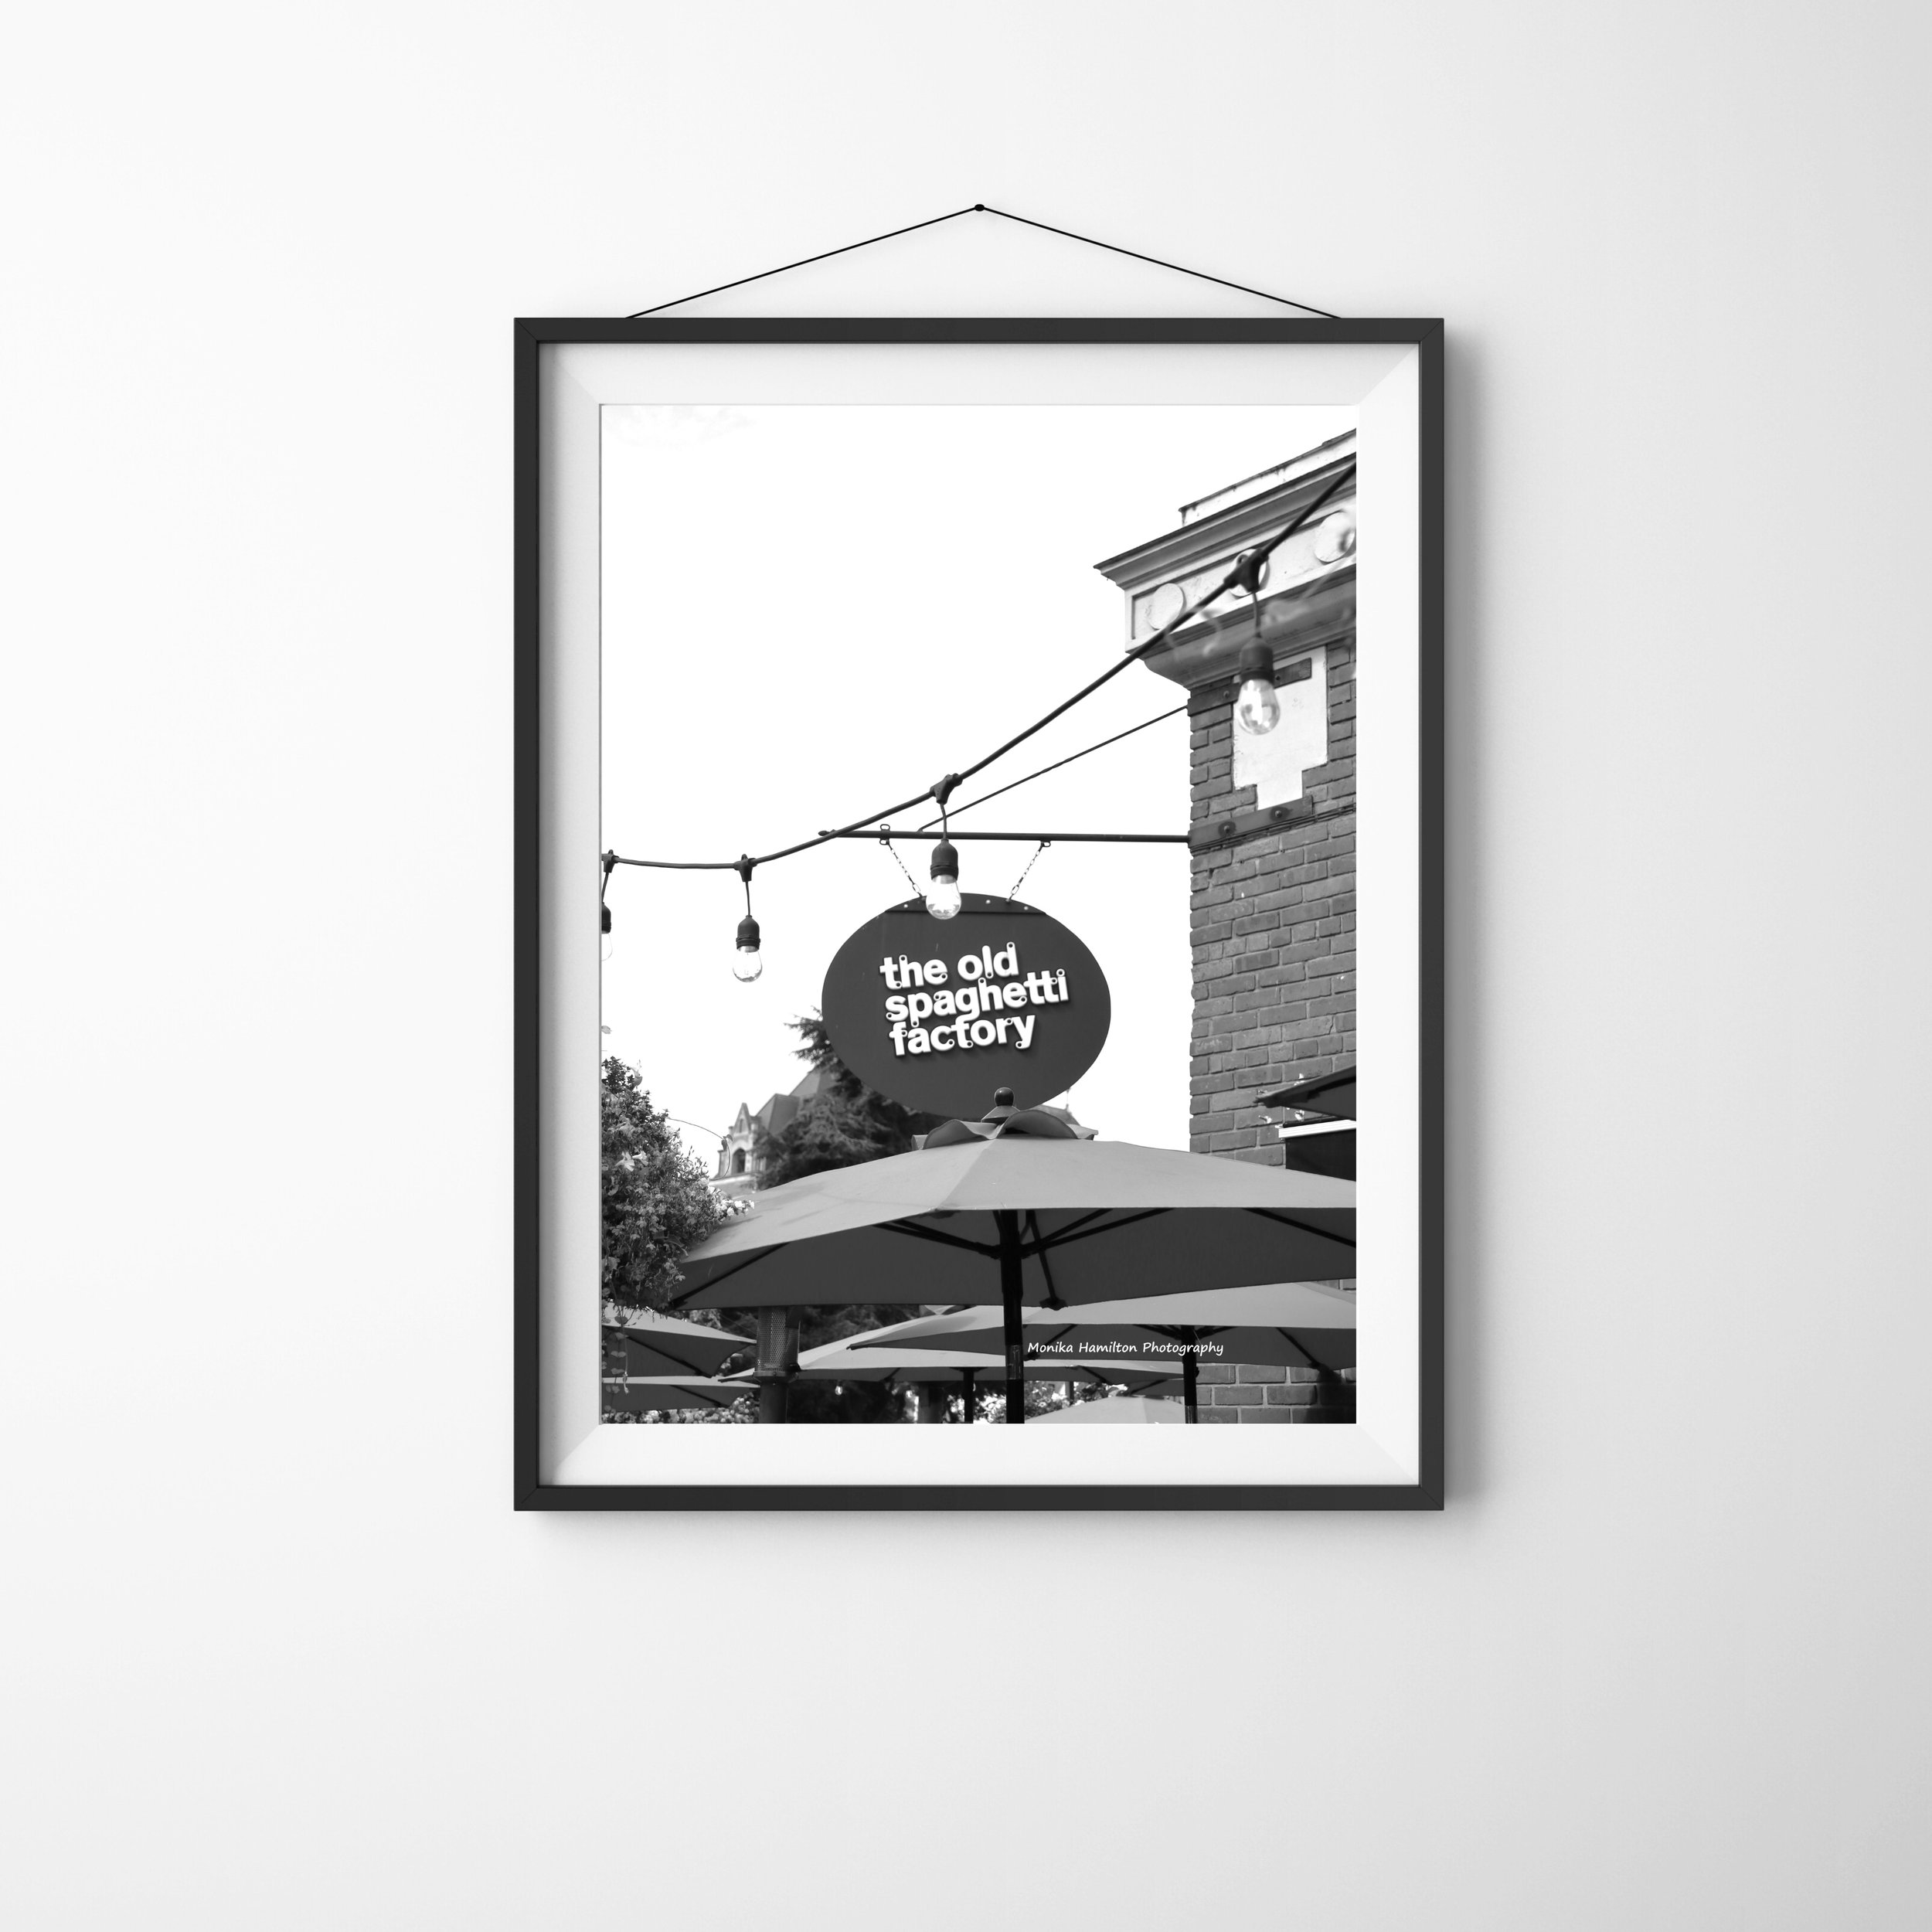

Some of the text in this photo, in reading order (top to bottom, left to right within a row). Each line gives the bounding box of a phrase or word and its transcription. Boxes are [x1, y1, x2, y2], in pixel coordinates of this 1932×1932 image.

[879, 941, 1019, 990] the old
[885, 968, 1069, 1027] spaghetti
[889, 1015, 1036, 1056] factory
